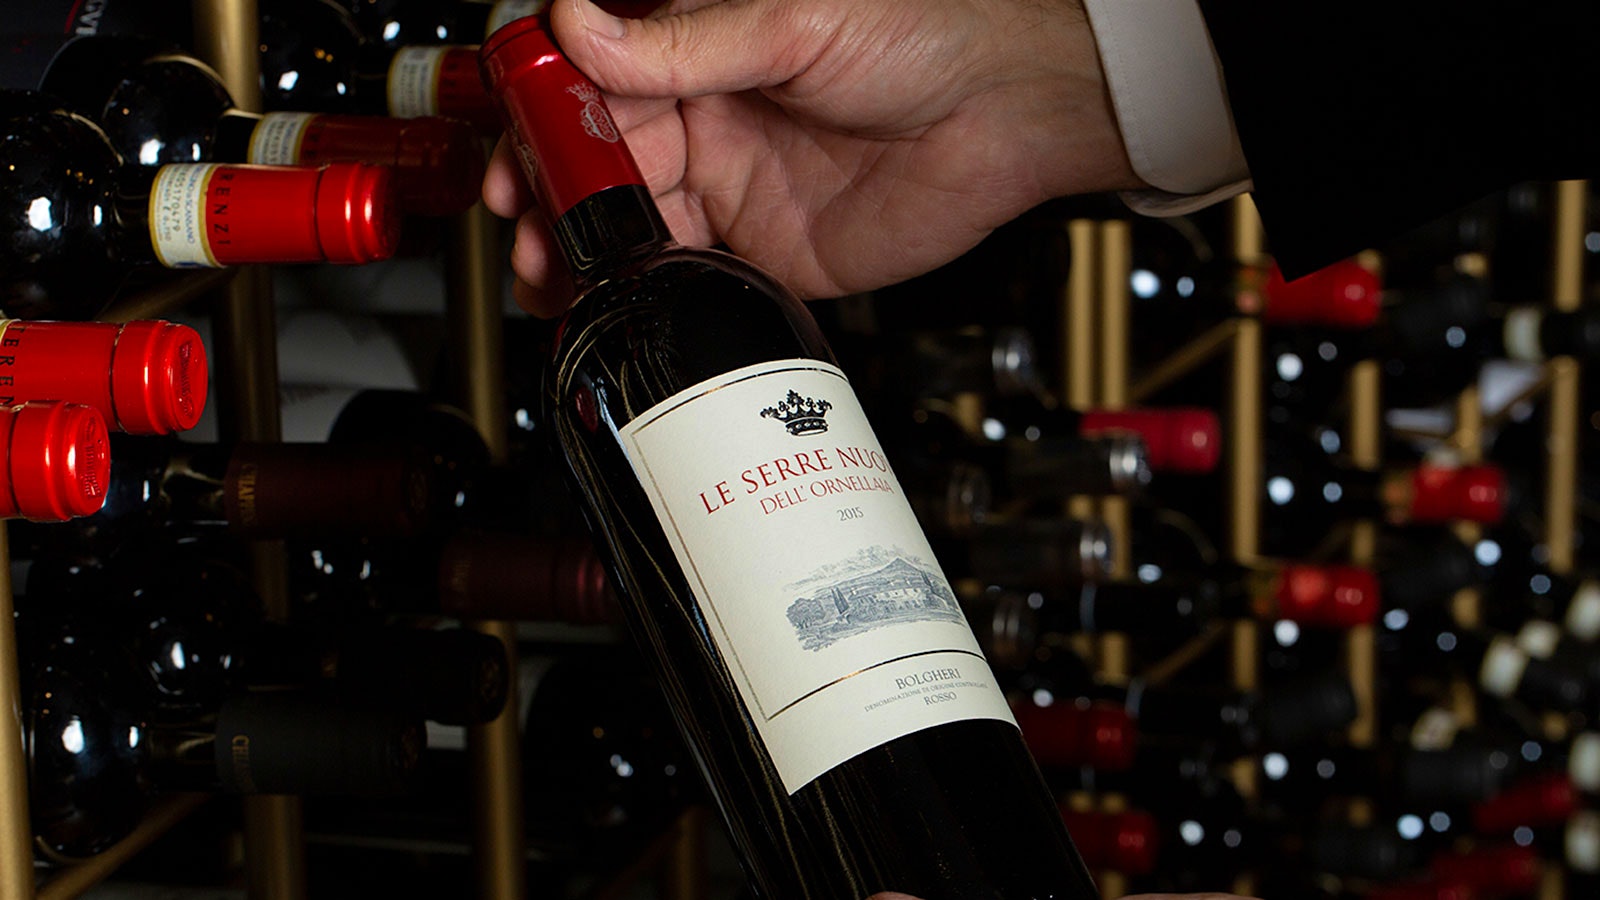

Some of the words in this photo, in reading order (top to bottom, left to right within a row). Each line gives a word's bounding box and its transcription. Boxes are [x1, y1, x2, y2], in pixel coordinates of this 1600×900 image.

[698, 480, 736, 515] LE
[741, 448, 833, 494] SERRE
[759, 484, 808, 515] DELL'
[809, 475, 894, 498] ORNELLAIA
[836, 506, 864, 522] 2015
[895, 668, 961, 690] BOLGHERI
[864, 689, 921, 712] DENOMINAZIONE
[923, 691, 958, 705] ROSSO
